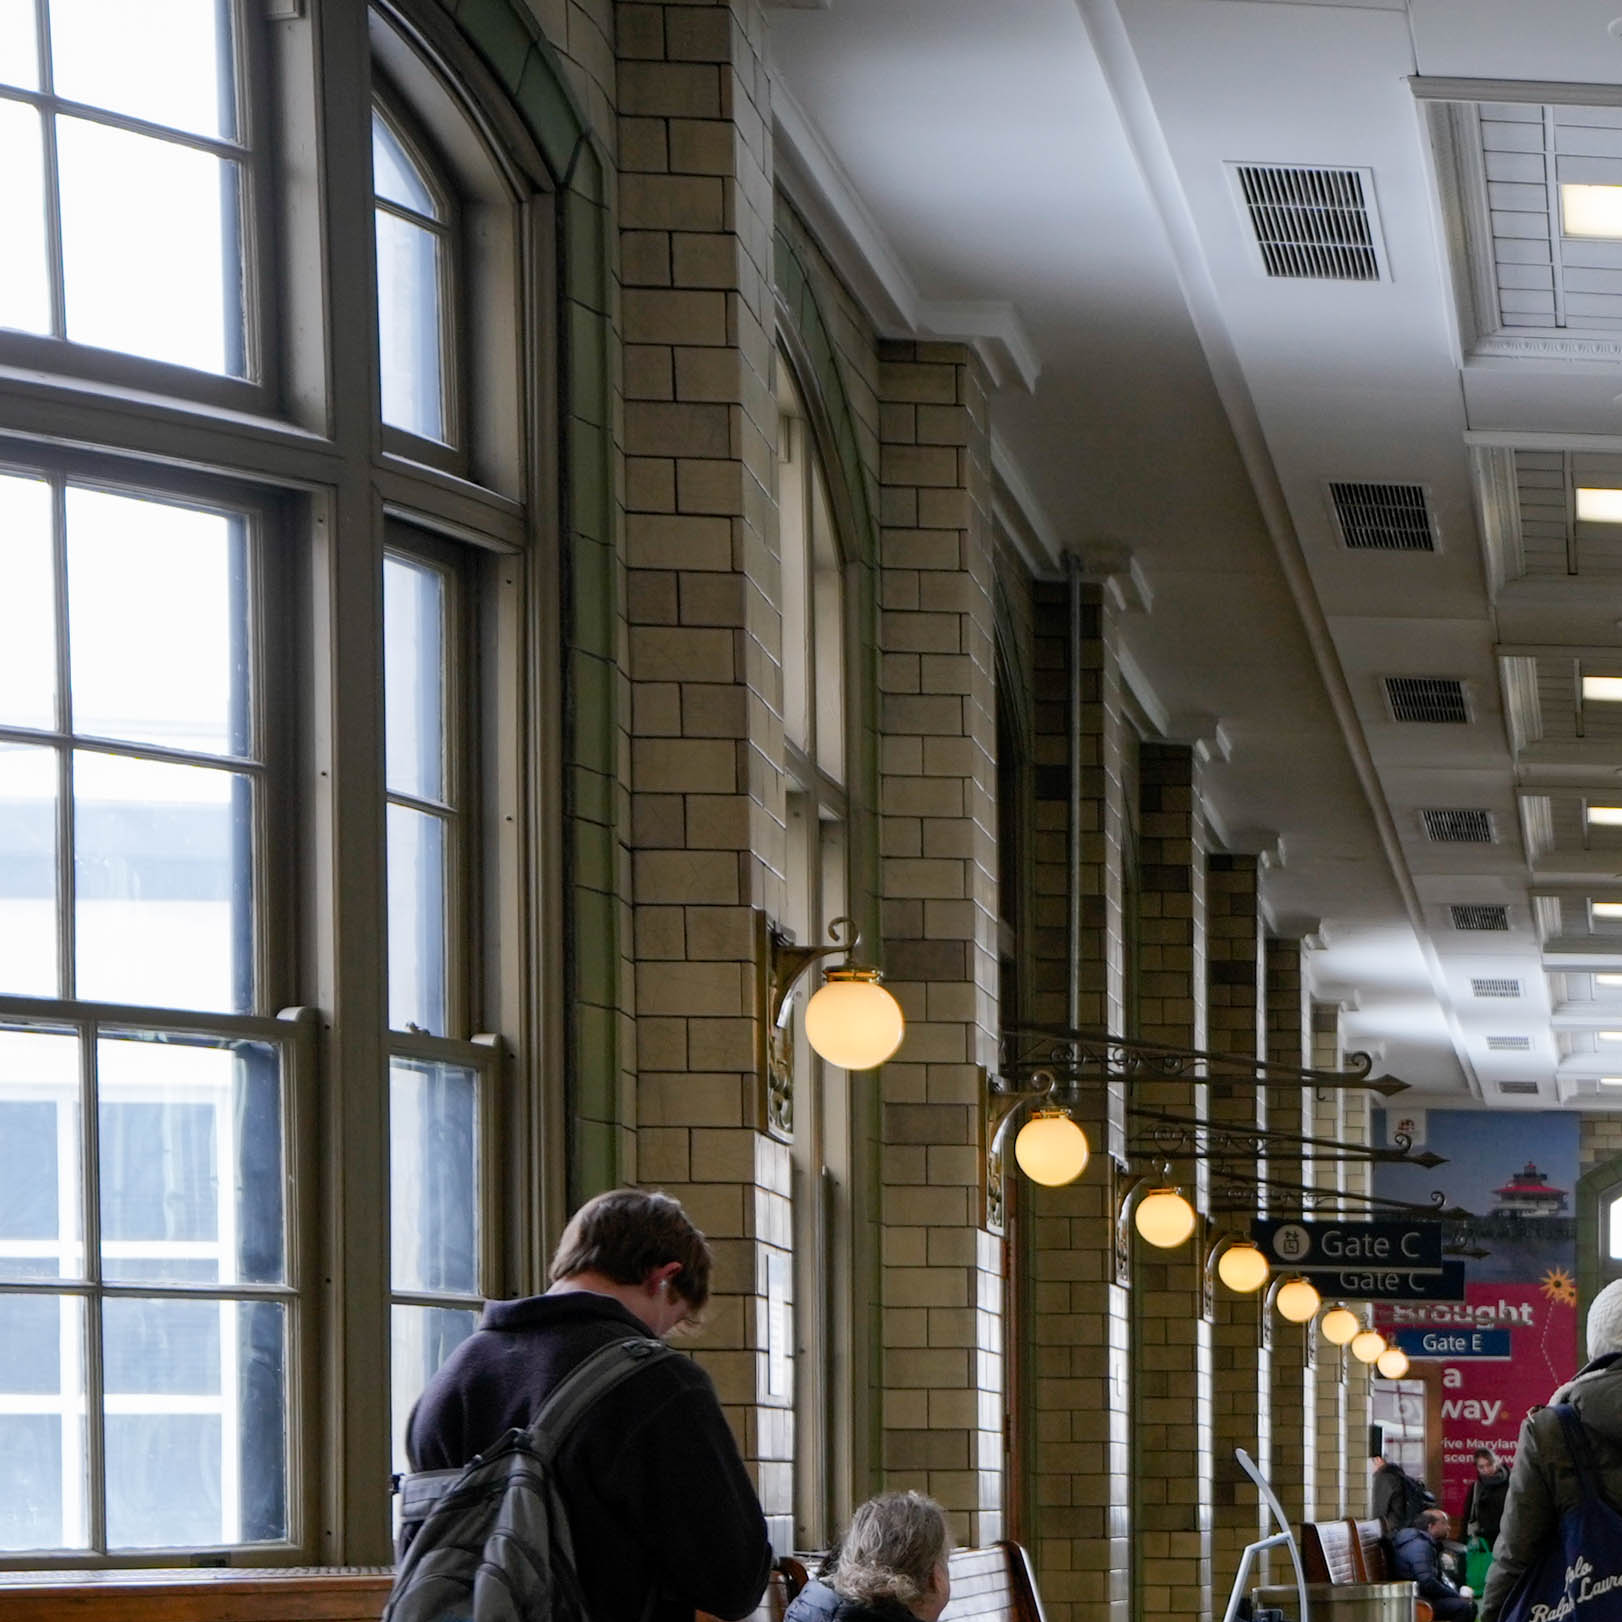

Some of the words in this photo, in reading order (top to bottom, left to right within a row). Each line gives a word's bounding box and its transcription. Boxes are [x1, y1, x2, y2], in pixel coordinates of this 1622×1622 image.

[1321, 1230, 1390, 1258] Gate
[1400, 1231, 1421, 1258] C
[1339, 1271, 1399, 1291] Gate
[1408, 1271, 1425, 1292] C
[1422, 1333, 1466, 1351] Gate
[1471, 1334, 1482, 1351] E
[1442, 1367, 1463, 1388] a
